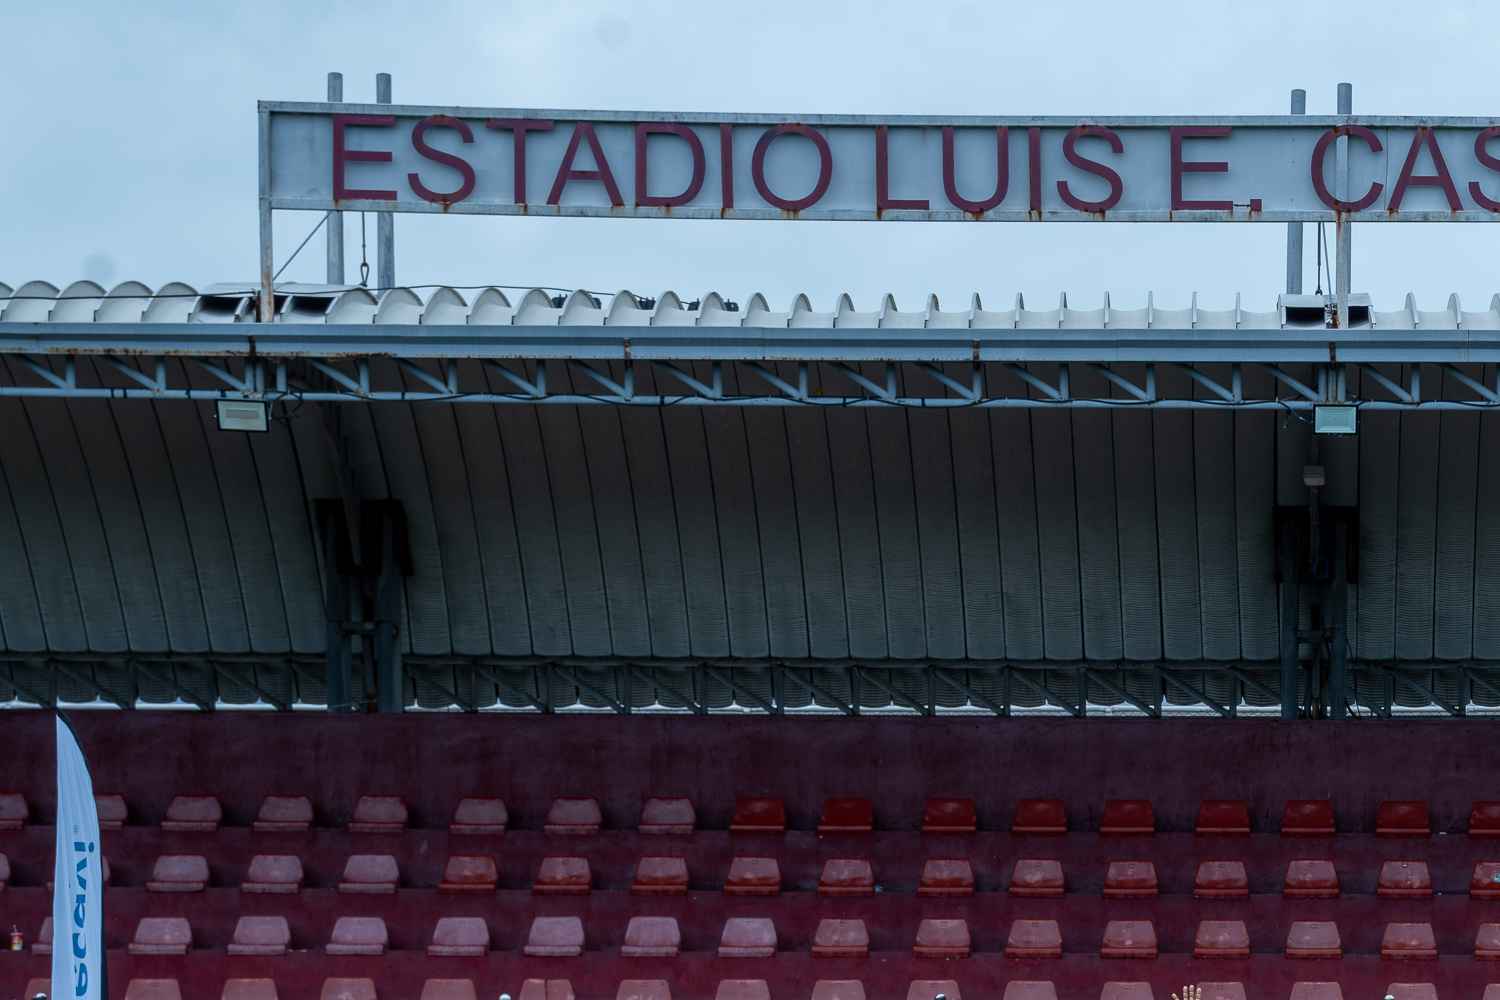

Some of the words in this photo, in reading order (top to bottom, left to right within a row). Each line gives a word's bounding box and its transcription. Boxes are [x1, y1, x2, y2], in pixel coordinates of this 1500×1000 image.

[332, 113, 833, 211] ESTADIO
[875, 125, 1124, 213] LUIS
[1170, 126, 1262, 212] E.
